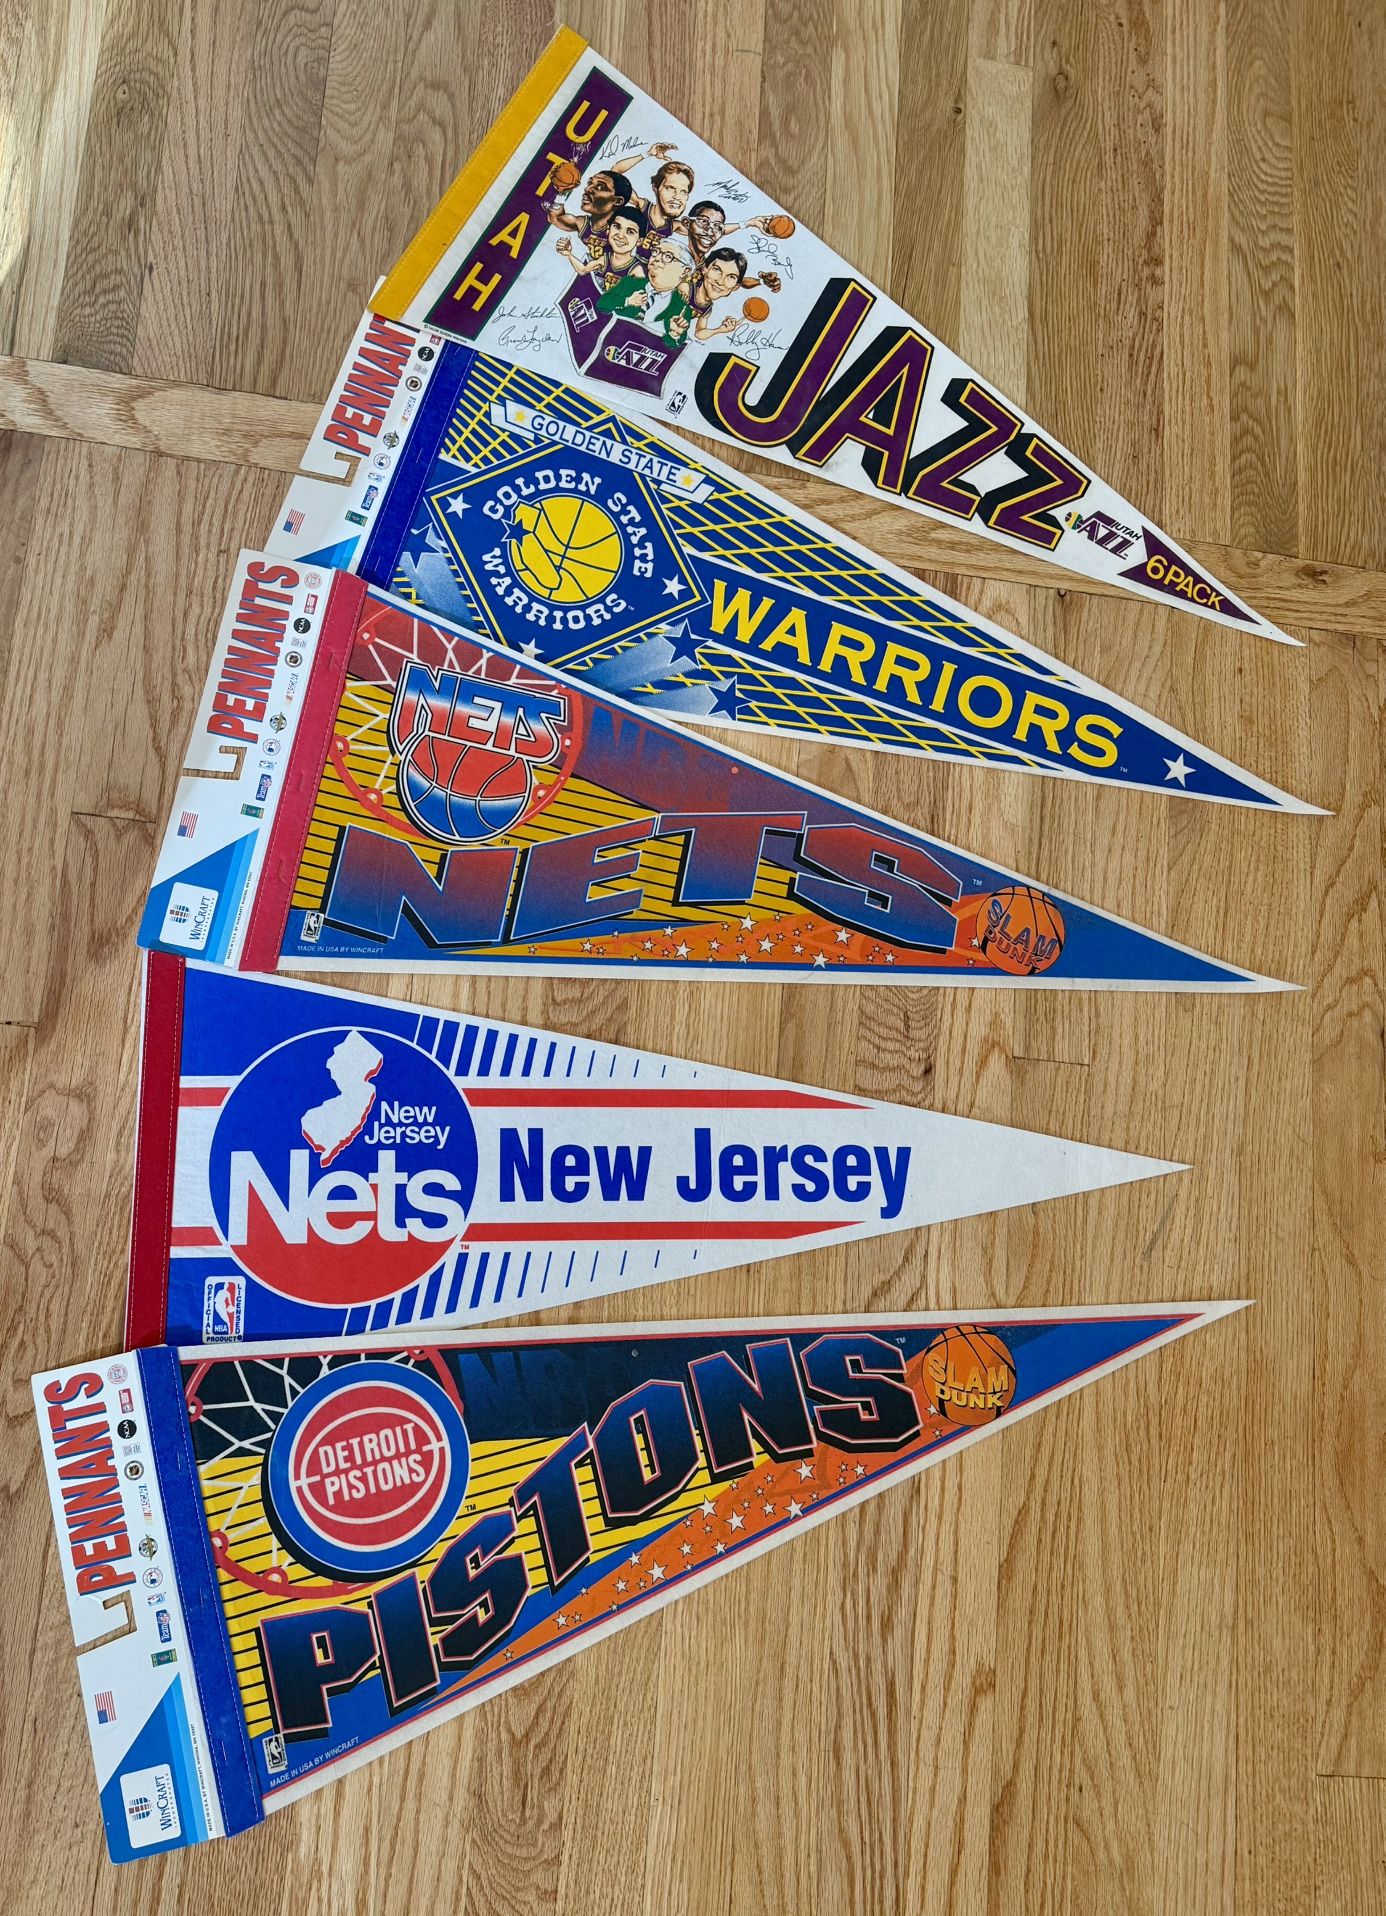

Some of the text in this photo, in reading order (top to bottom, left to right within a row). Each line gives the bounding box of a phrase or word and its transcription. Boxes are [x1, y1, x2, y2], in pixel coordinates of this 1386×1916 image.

[454, 100, 609, 312] UTAH
[323, 313, 421, 457] PENNAN
[694, 277, 1092, 552] JAZZ
[530, 413, 681, 484] GOLDEN STATE
[482, 468, 654, 578] GOLDEN STATE
[481, 547, 628, 630] WARRIORS
[207, 561, 300, 744] PENNANTS
[710, 579, 1124, 768] WARRIORS
[393, 660, 567, 763] NETS
[319, 811, 962, 954] NETS
[984, 924, 1043, 970] DUNK
[987, 898, 1059, 960] SLAM
[364, 1120, 450, 1149] Jersey
[380, 1100, 437, 1124] New
[228, 1149, 466, 1245] Nets
[499, 1127, 911, 1219] New Jersey
[928, 1352, 1009, 1395] SLAM
[934, 1383, 1005, 1411] DUNK
[121, 1419, 131, 1438] NCAA
[318, 1422, 417, 1475] DETROIT
[43, 1372, 137, 1596] PENNANTS
[323, 1454, 426, 1507] PISTONS
[257, 1333, 923, 1743] PISTONS
[270, 1736, 360, 1788] MADE IN USA BY WINCRAFT
